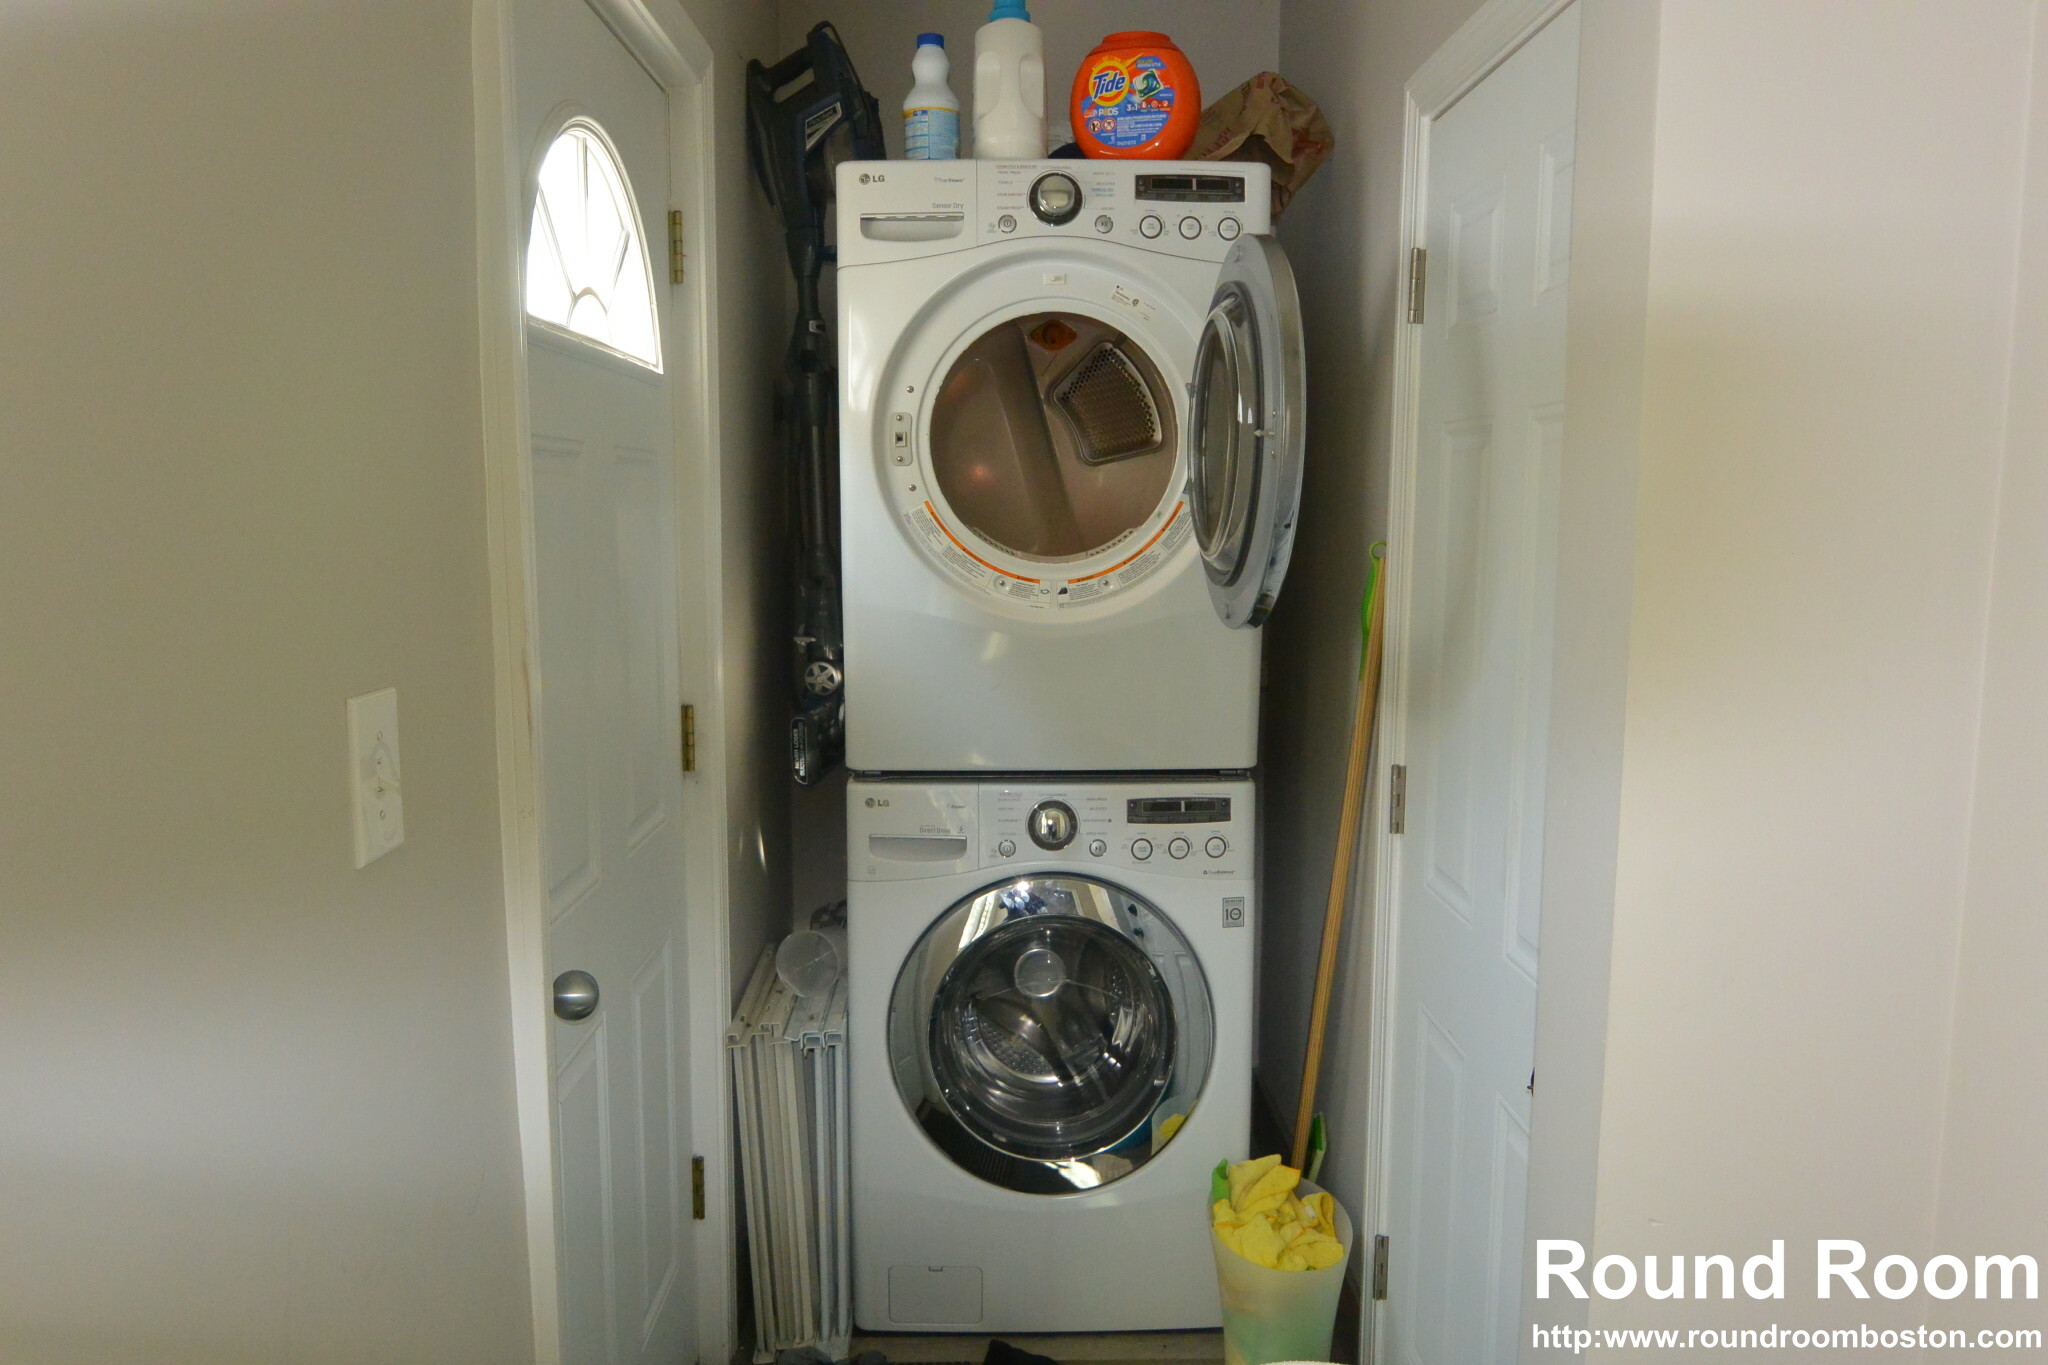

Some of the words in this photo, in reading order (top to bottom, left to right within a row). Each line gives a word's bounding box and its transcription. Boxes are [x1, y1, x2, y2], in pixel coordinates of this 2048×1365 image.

[1093, 70, 1126, 101] Tide
[1098, 107, 1119, 116] PODS
[872, 174, 885, 183] LG
[953, 202, 964, 210] Dry
[877, 799, 890, 807] LG
